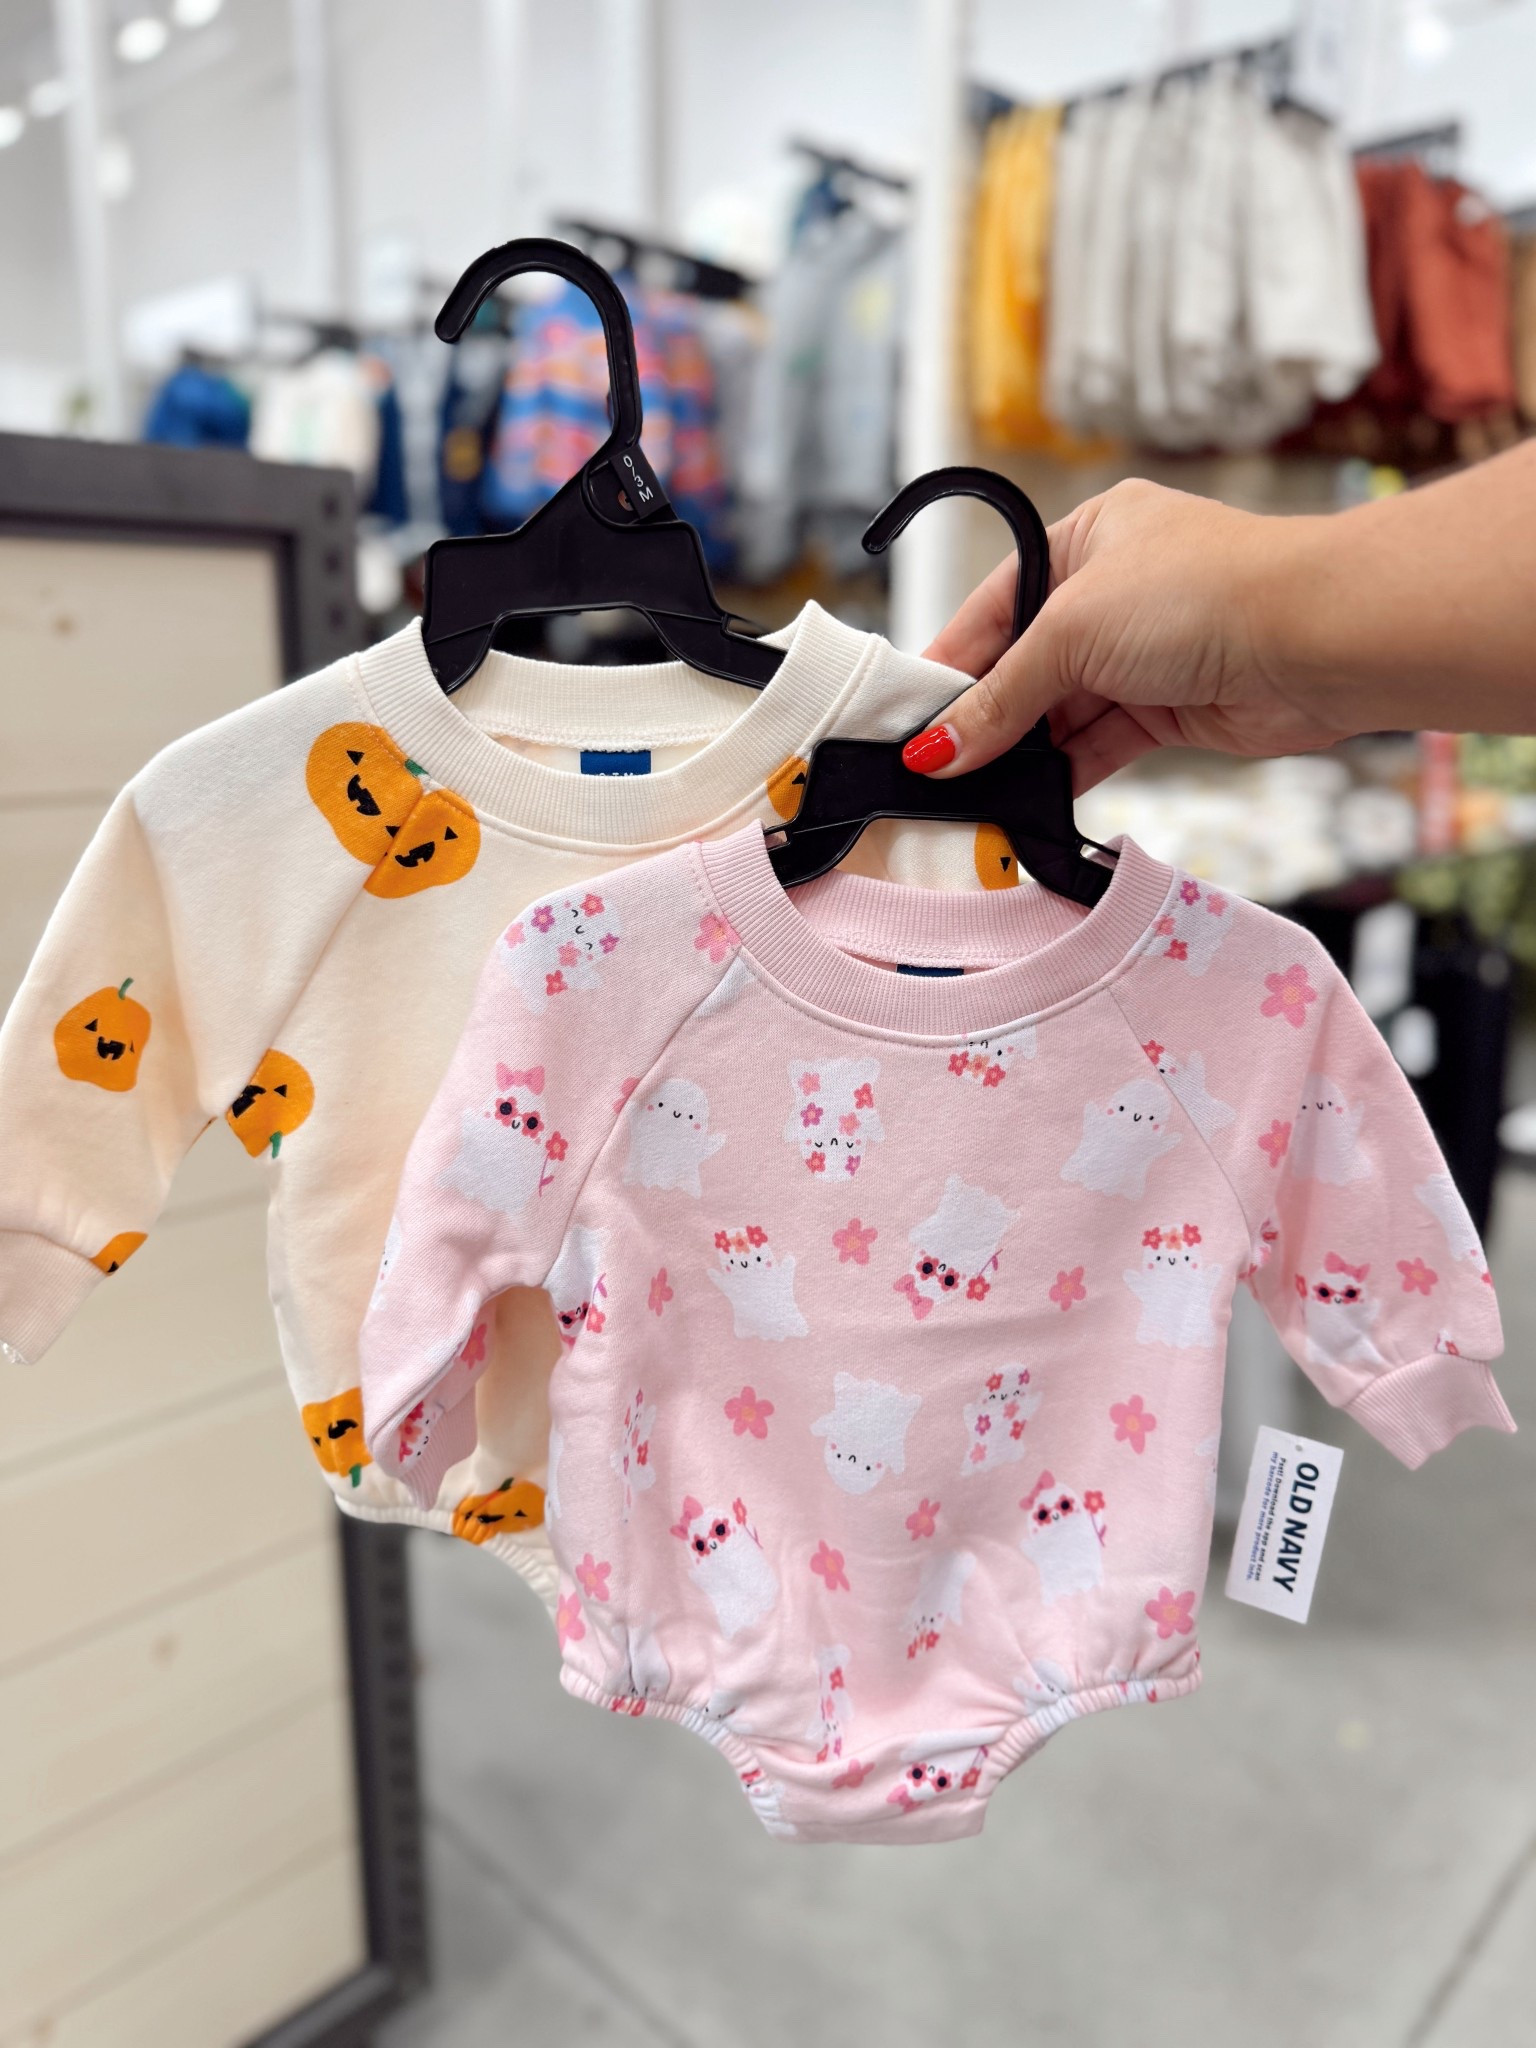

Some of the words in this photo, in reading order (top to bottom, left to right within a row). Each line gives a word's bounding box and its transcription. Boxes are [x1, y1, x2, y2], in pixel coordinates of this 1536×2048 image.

[1270, 1451, 1279, 1464] my
[1264, 1465, 1274, 1496] barcode
[1289, 1462, 1320, 1514] OLD
[1269, 1478, 1282, 1516] Download
[1257, 1510, 1265, 1531] more
[1265, 1516, 1274, 1530] the
[1250, 1531, 1261, 1562] product
[1261, 1531, 1269, 1547] app
[1258, 1548, 1266, 1564] and
[1273, 1518, 1308, 1594] NAVY
